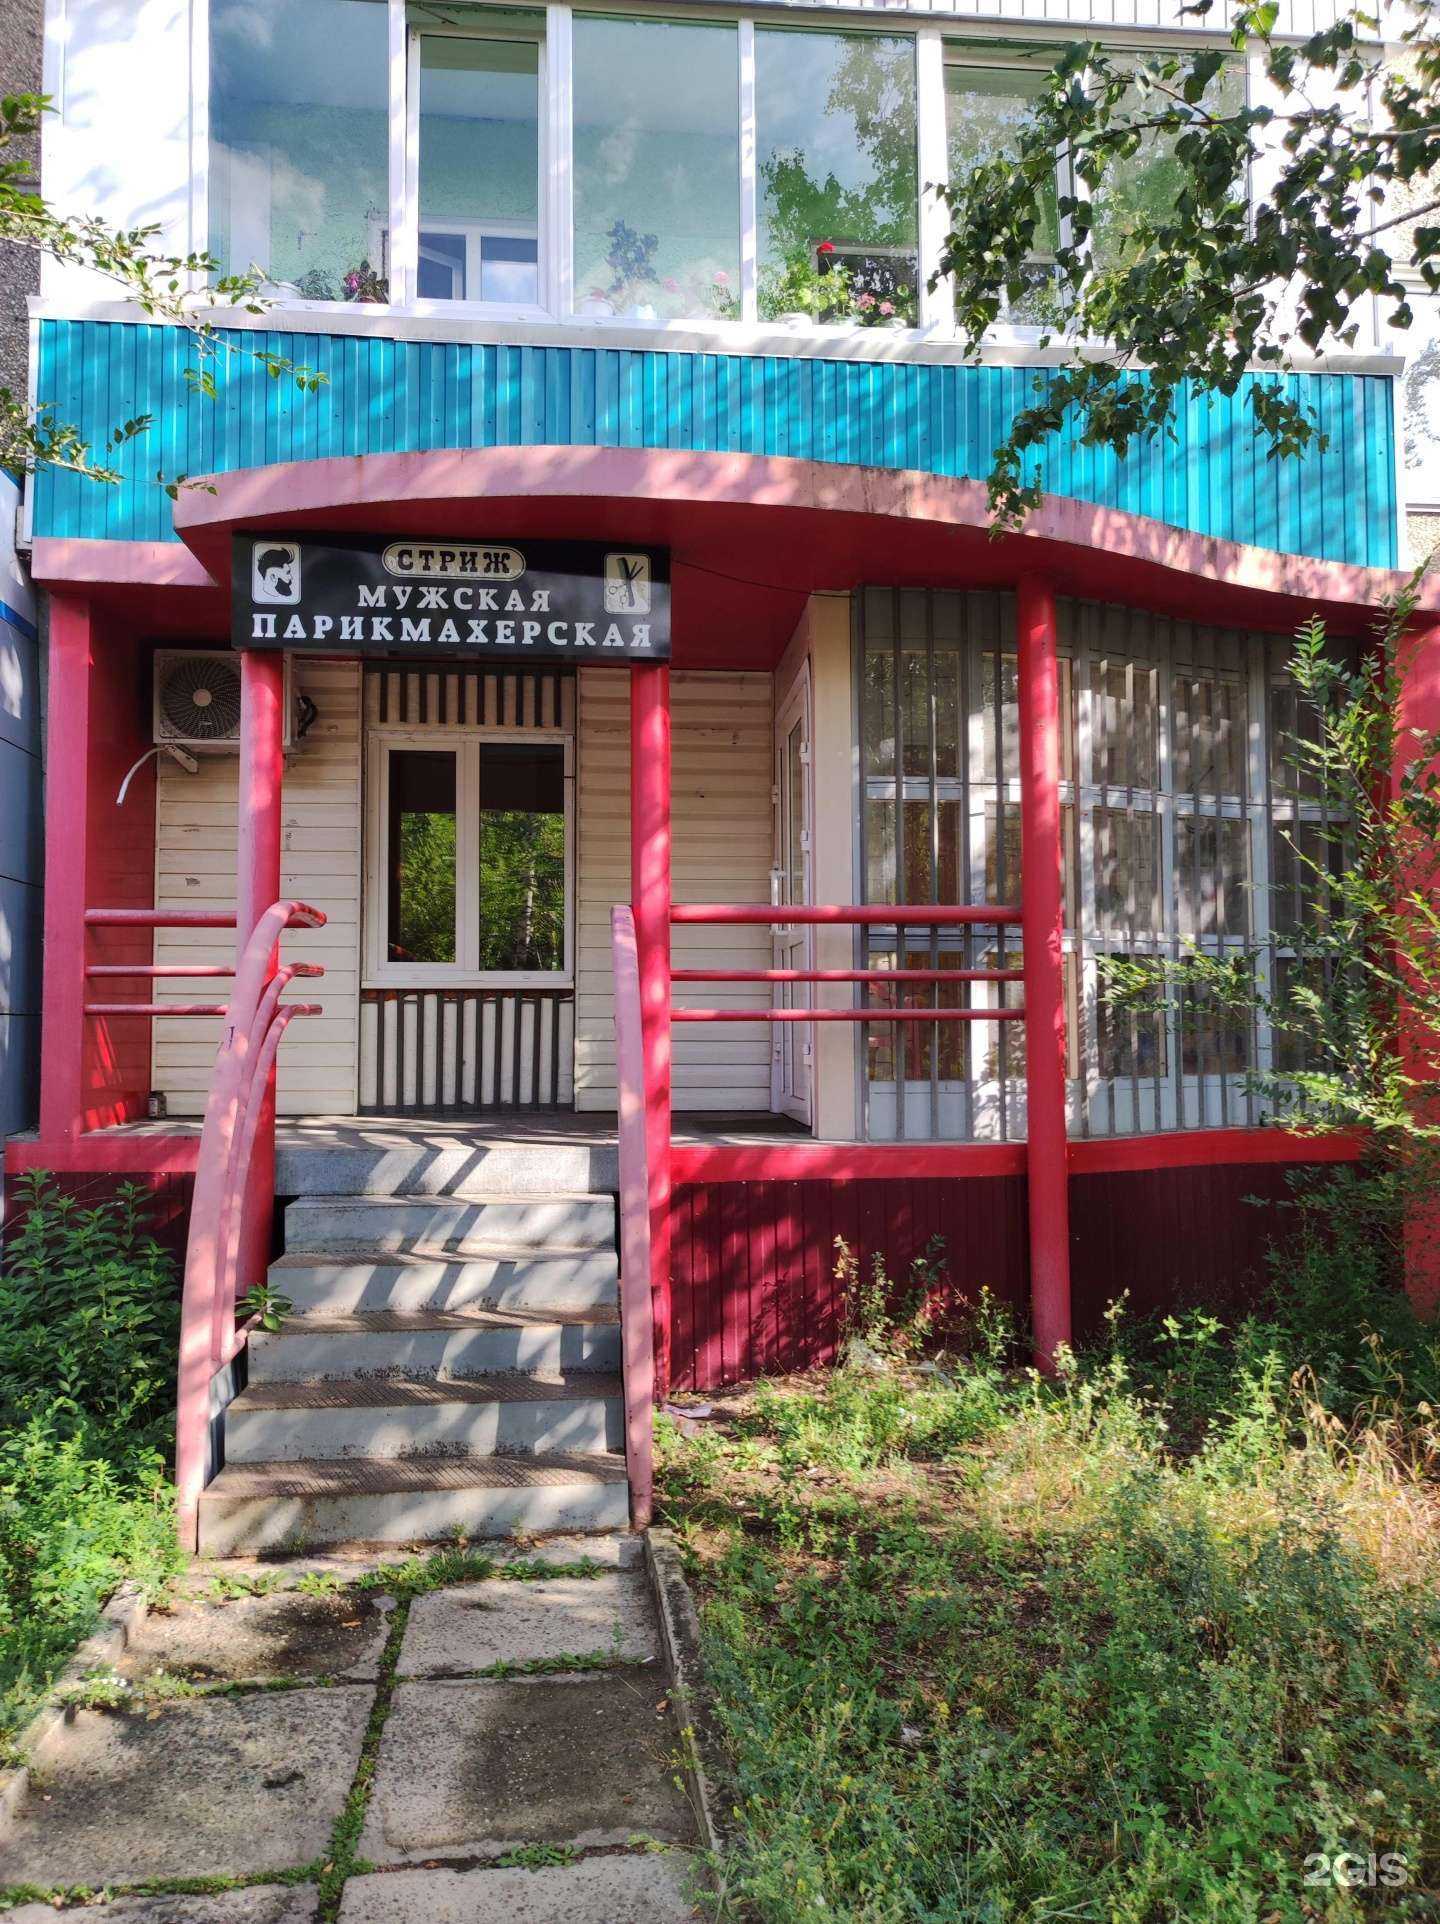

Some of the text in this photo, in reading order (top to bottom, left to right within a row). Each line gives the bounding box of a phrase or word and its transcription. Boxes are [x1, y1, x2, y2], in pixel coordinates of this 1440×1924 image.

[396, 549, 511, 574] СТРИЖ
[357, 584, 551, 612] МУЖСКАЯ
[251, 613, 652, 647] ПАРИКМАХЕРСКАЯ
